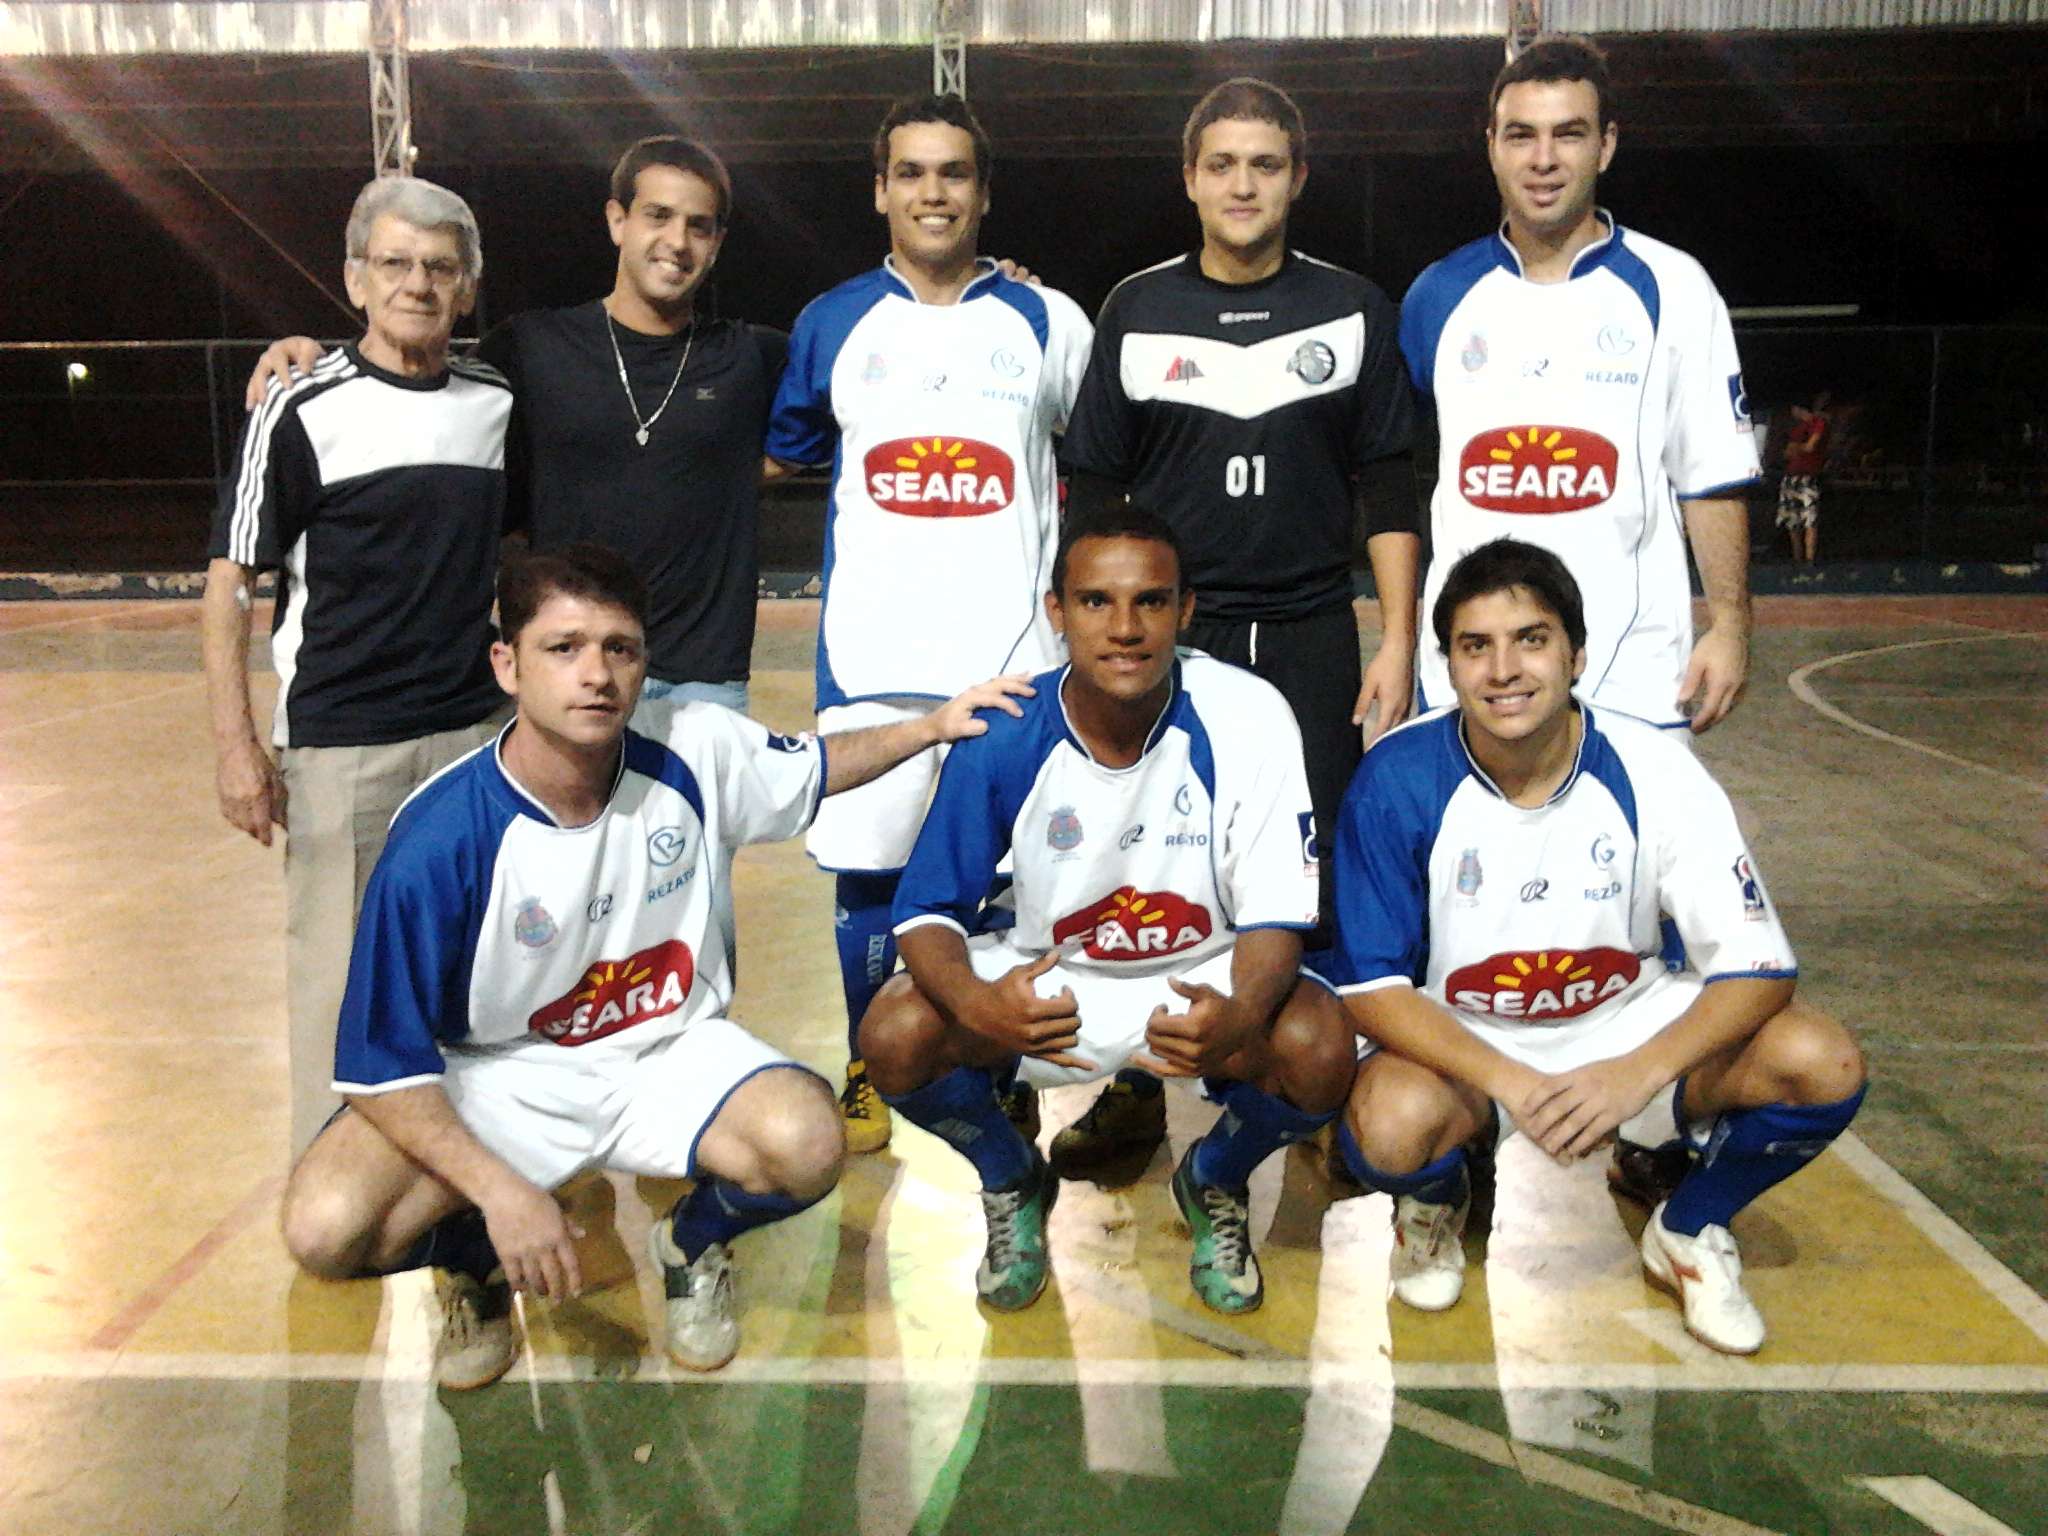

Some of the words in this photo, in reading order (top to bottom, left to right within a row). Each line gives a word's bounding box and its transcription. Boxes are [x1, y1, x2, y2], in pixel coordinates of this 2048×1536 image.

[871, 471, 1008, 506] SEARA
[1226, 455, 1265, 497] 01
[1463, 463, 1610, 499] SEARA
[1454, 972, 1630, 1016] SEARA
